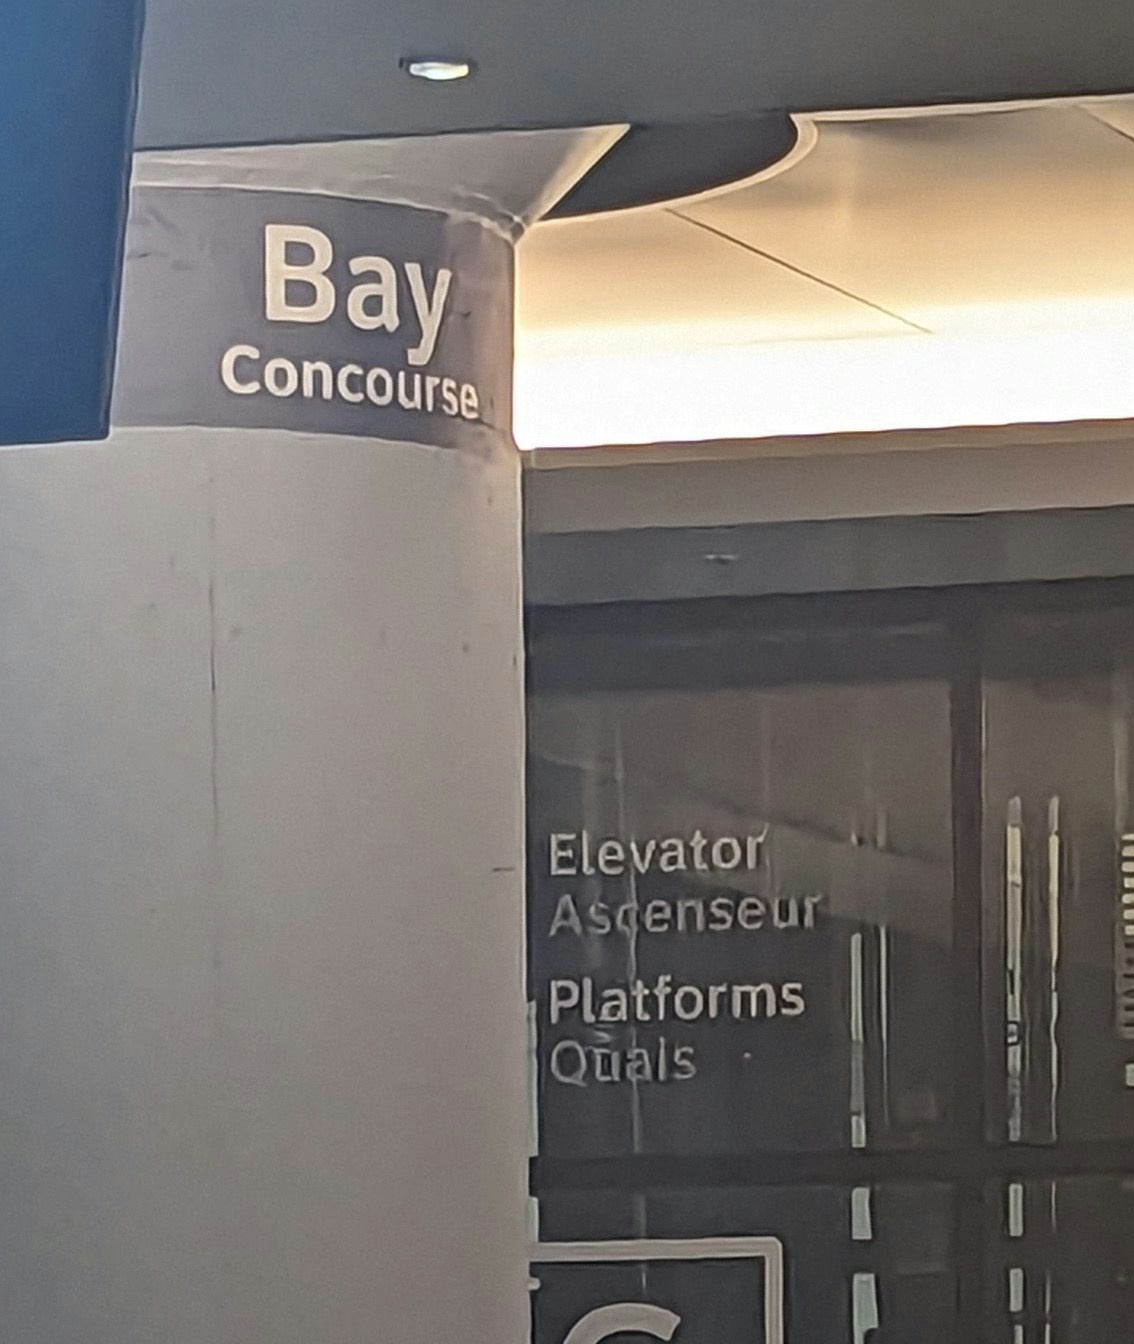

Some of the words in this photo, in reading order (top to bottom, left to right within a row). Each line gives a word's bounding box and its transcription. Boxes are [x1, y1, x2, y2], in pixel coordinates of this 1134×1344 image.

[264, 223, 452, 367] Bay
[220, 344, 480, 420] Concourse
[550, 829, 768, 876] Elevator
[549, 893, 822, 937] Ascenseur
[550, 973, 806, 1025] Platforms
